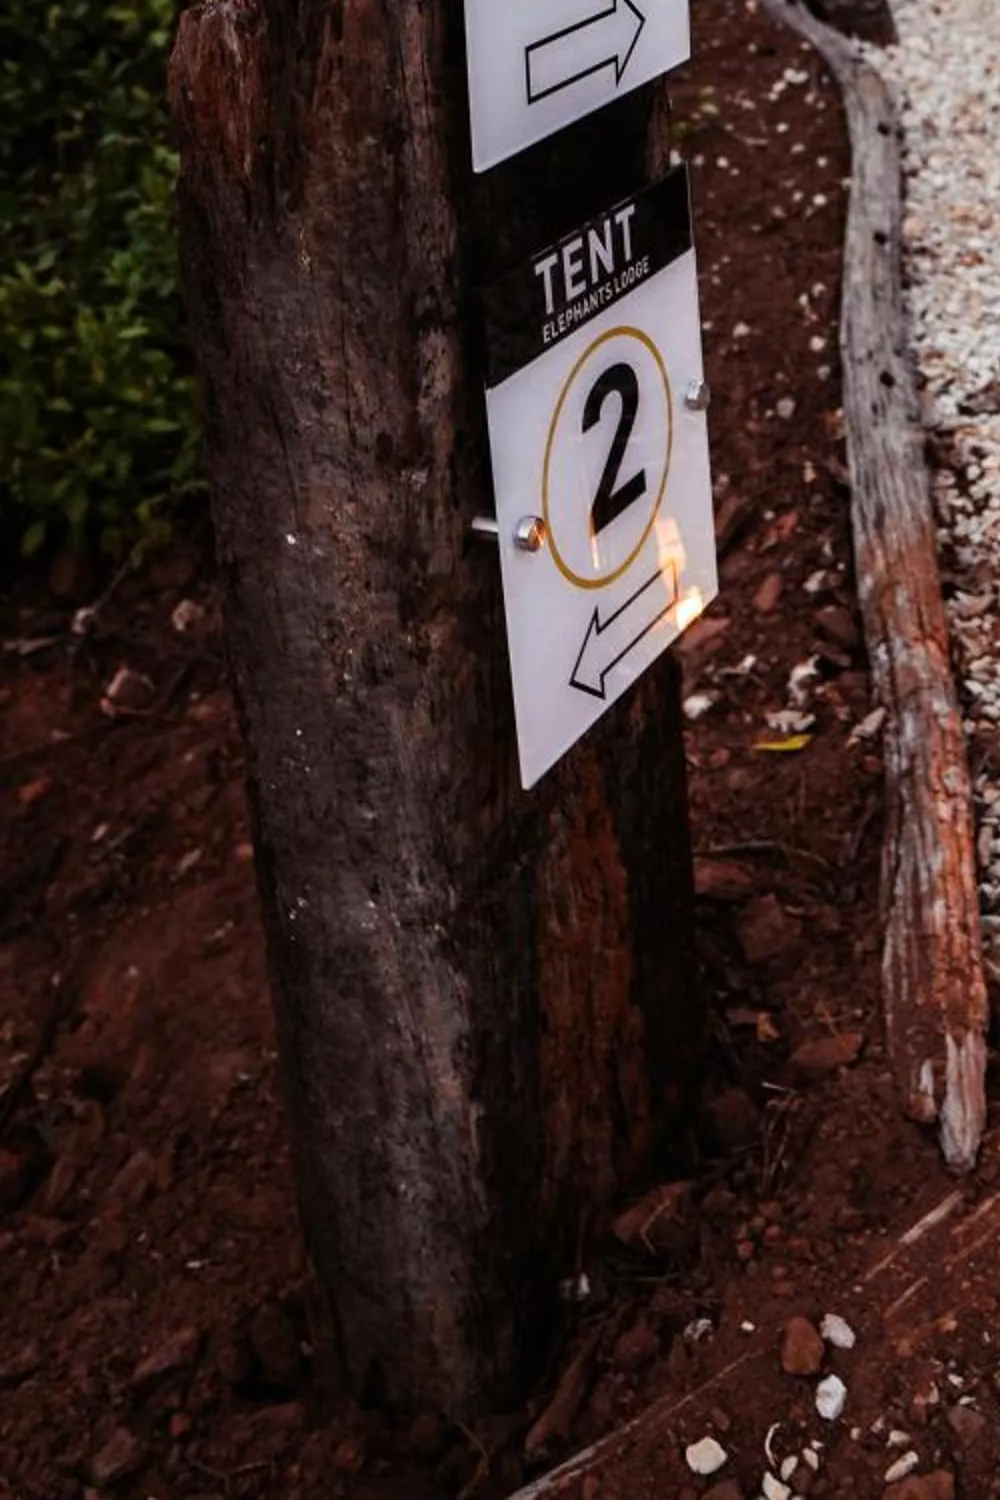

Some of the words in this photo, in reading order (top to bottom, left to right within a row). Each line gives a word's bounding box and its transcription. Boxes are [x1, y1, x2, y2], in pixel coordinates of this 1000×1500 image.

[534, 203, 636, 315] TENT
[542, 288, 613, 343] ELEPHANTS
[614, 255, 650, 295] LODGE
[582, 363, 646, 535] 2
